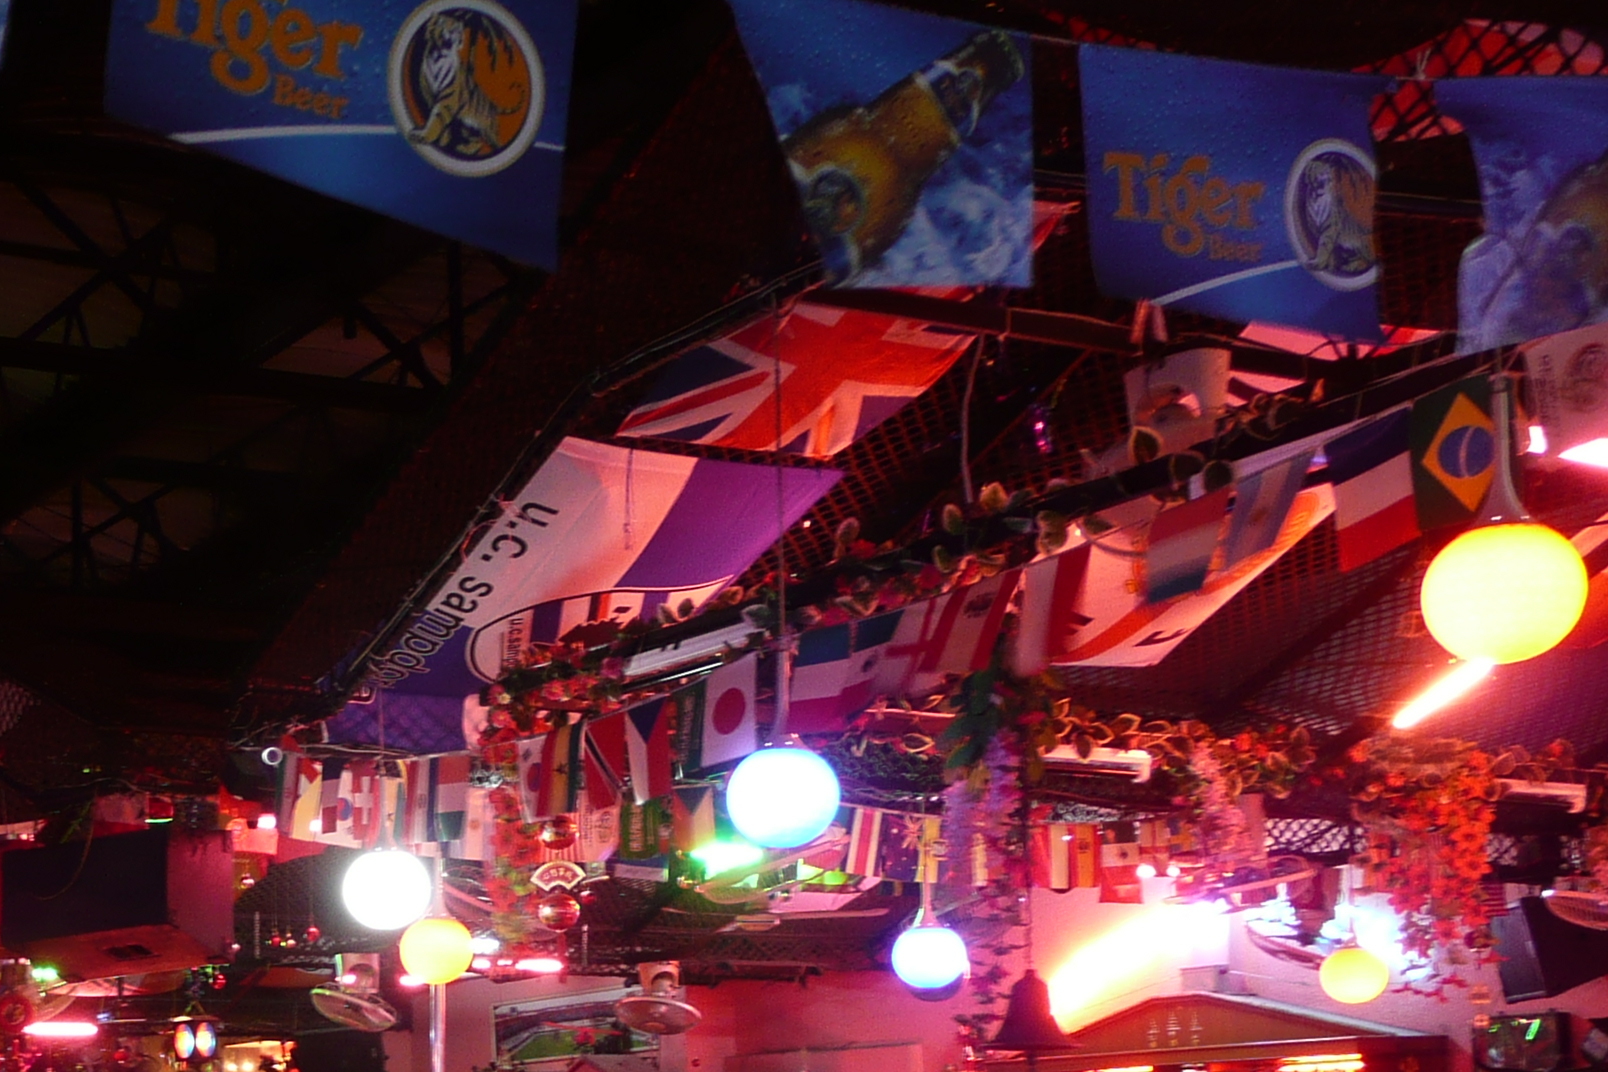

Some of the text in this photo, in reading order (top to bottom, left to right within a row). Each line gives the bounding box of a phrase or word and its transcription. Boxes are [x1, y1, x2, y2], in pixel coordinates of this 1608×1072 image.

[272, 73, 349, 118] Beer
[1102, 151, 1267, 257] Tiger
[1209, 235, 1264, 262] Beer
